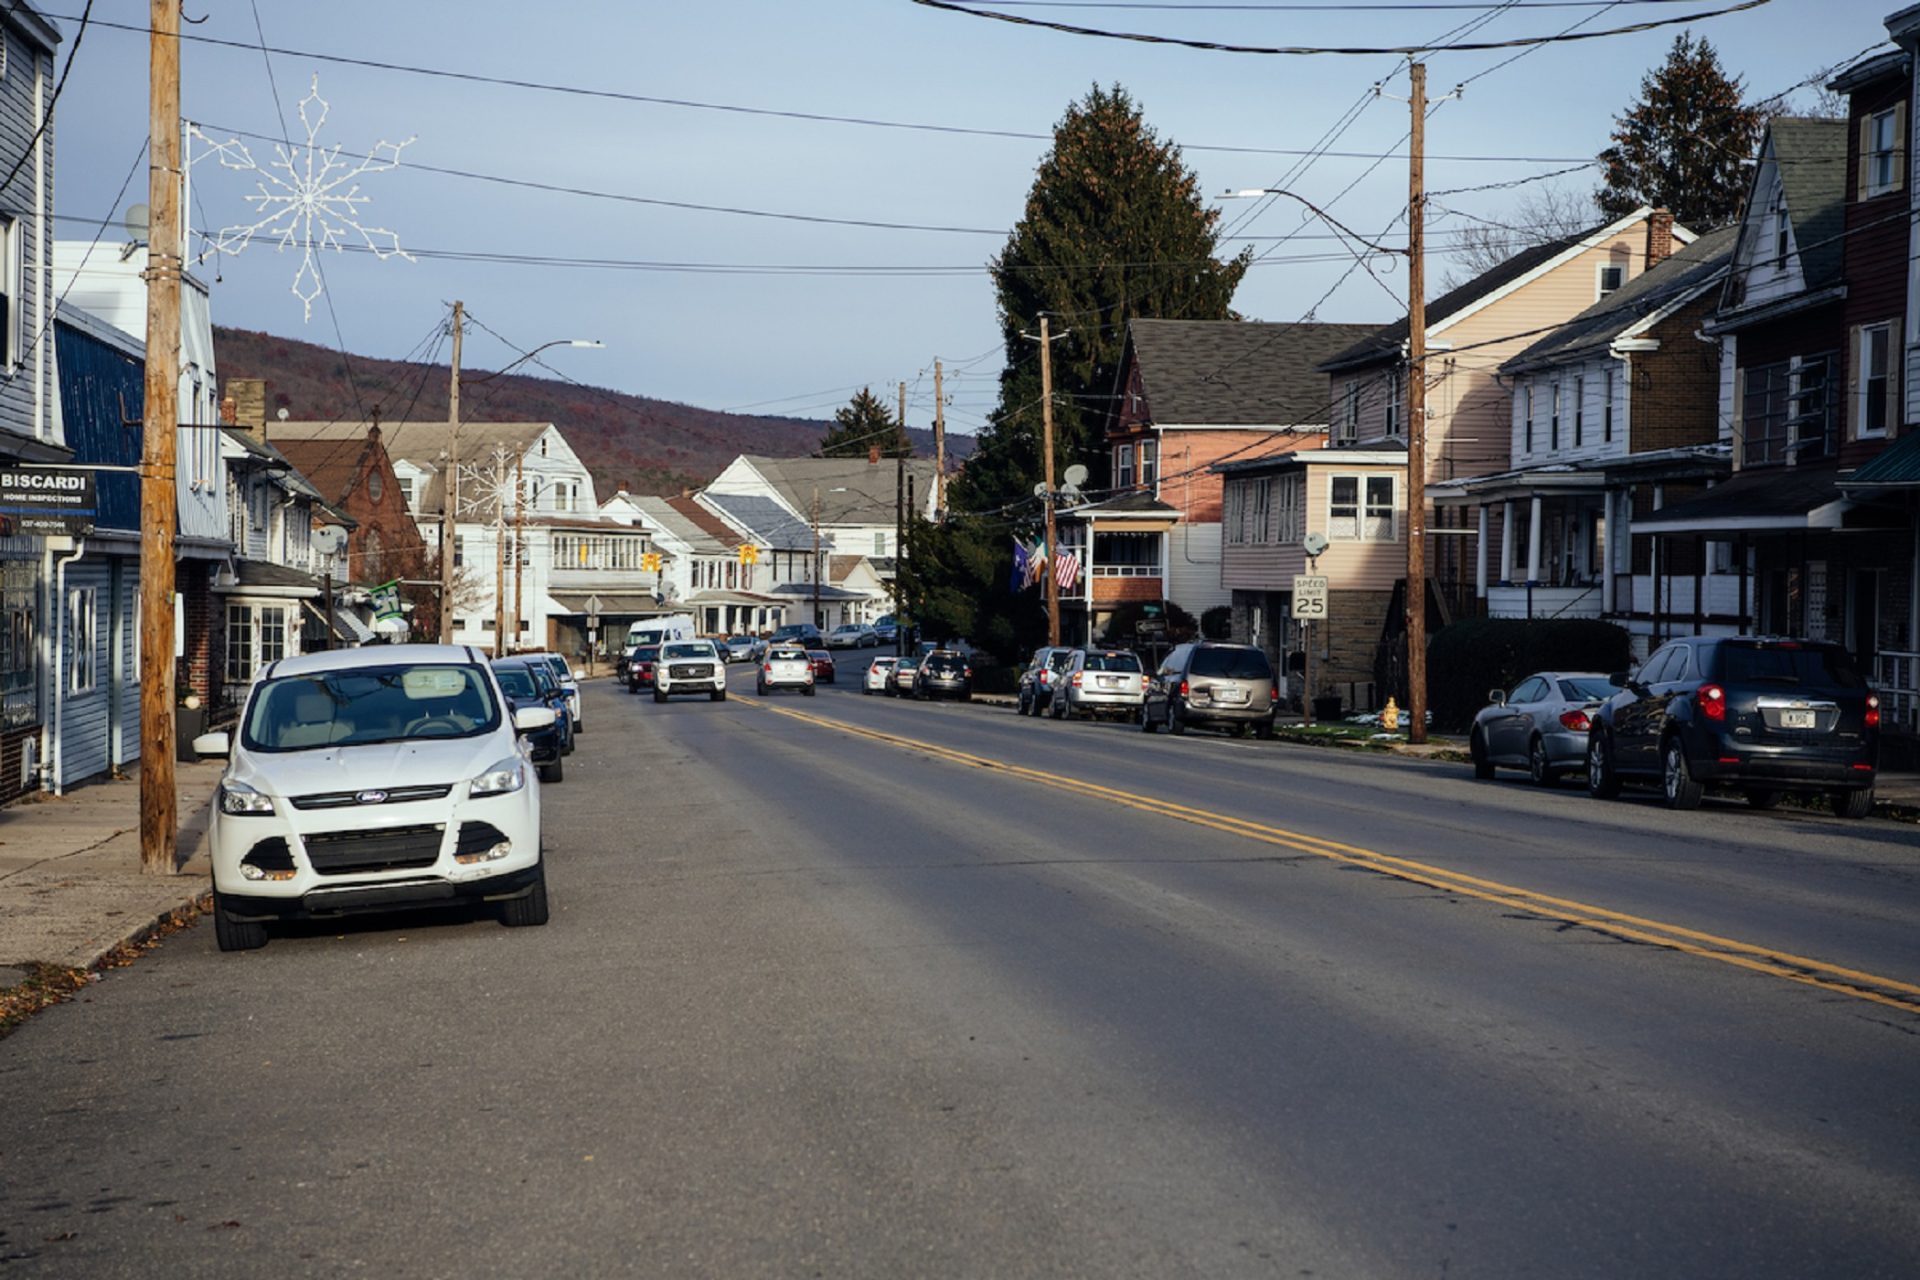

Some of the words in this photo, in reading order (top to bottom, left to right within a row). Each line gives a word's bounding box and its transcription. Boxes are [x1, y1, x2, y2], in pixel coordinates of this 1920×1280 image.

[1, 473, 86, 490] BISCARDI
[3, 493, 27, 501] HOME
[28, 494, 82, 503] INSPECTIONS
[1296, 579, 1326, 588] SPEED
[1297, 598, 1324, 613] 25
